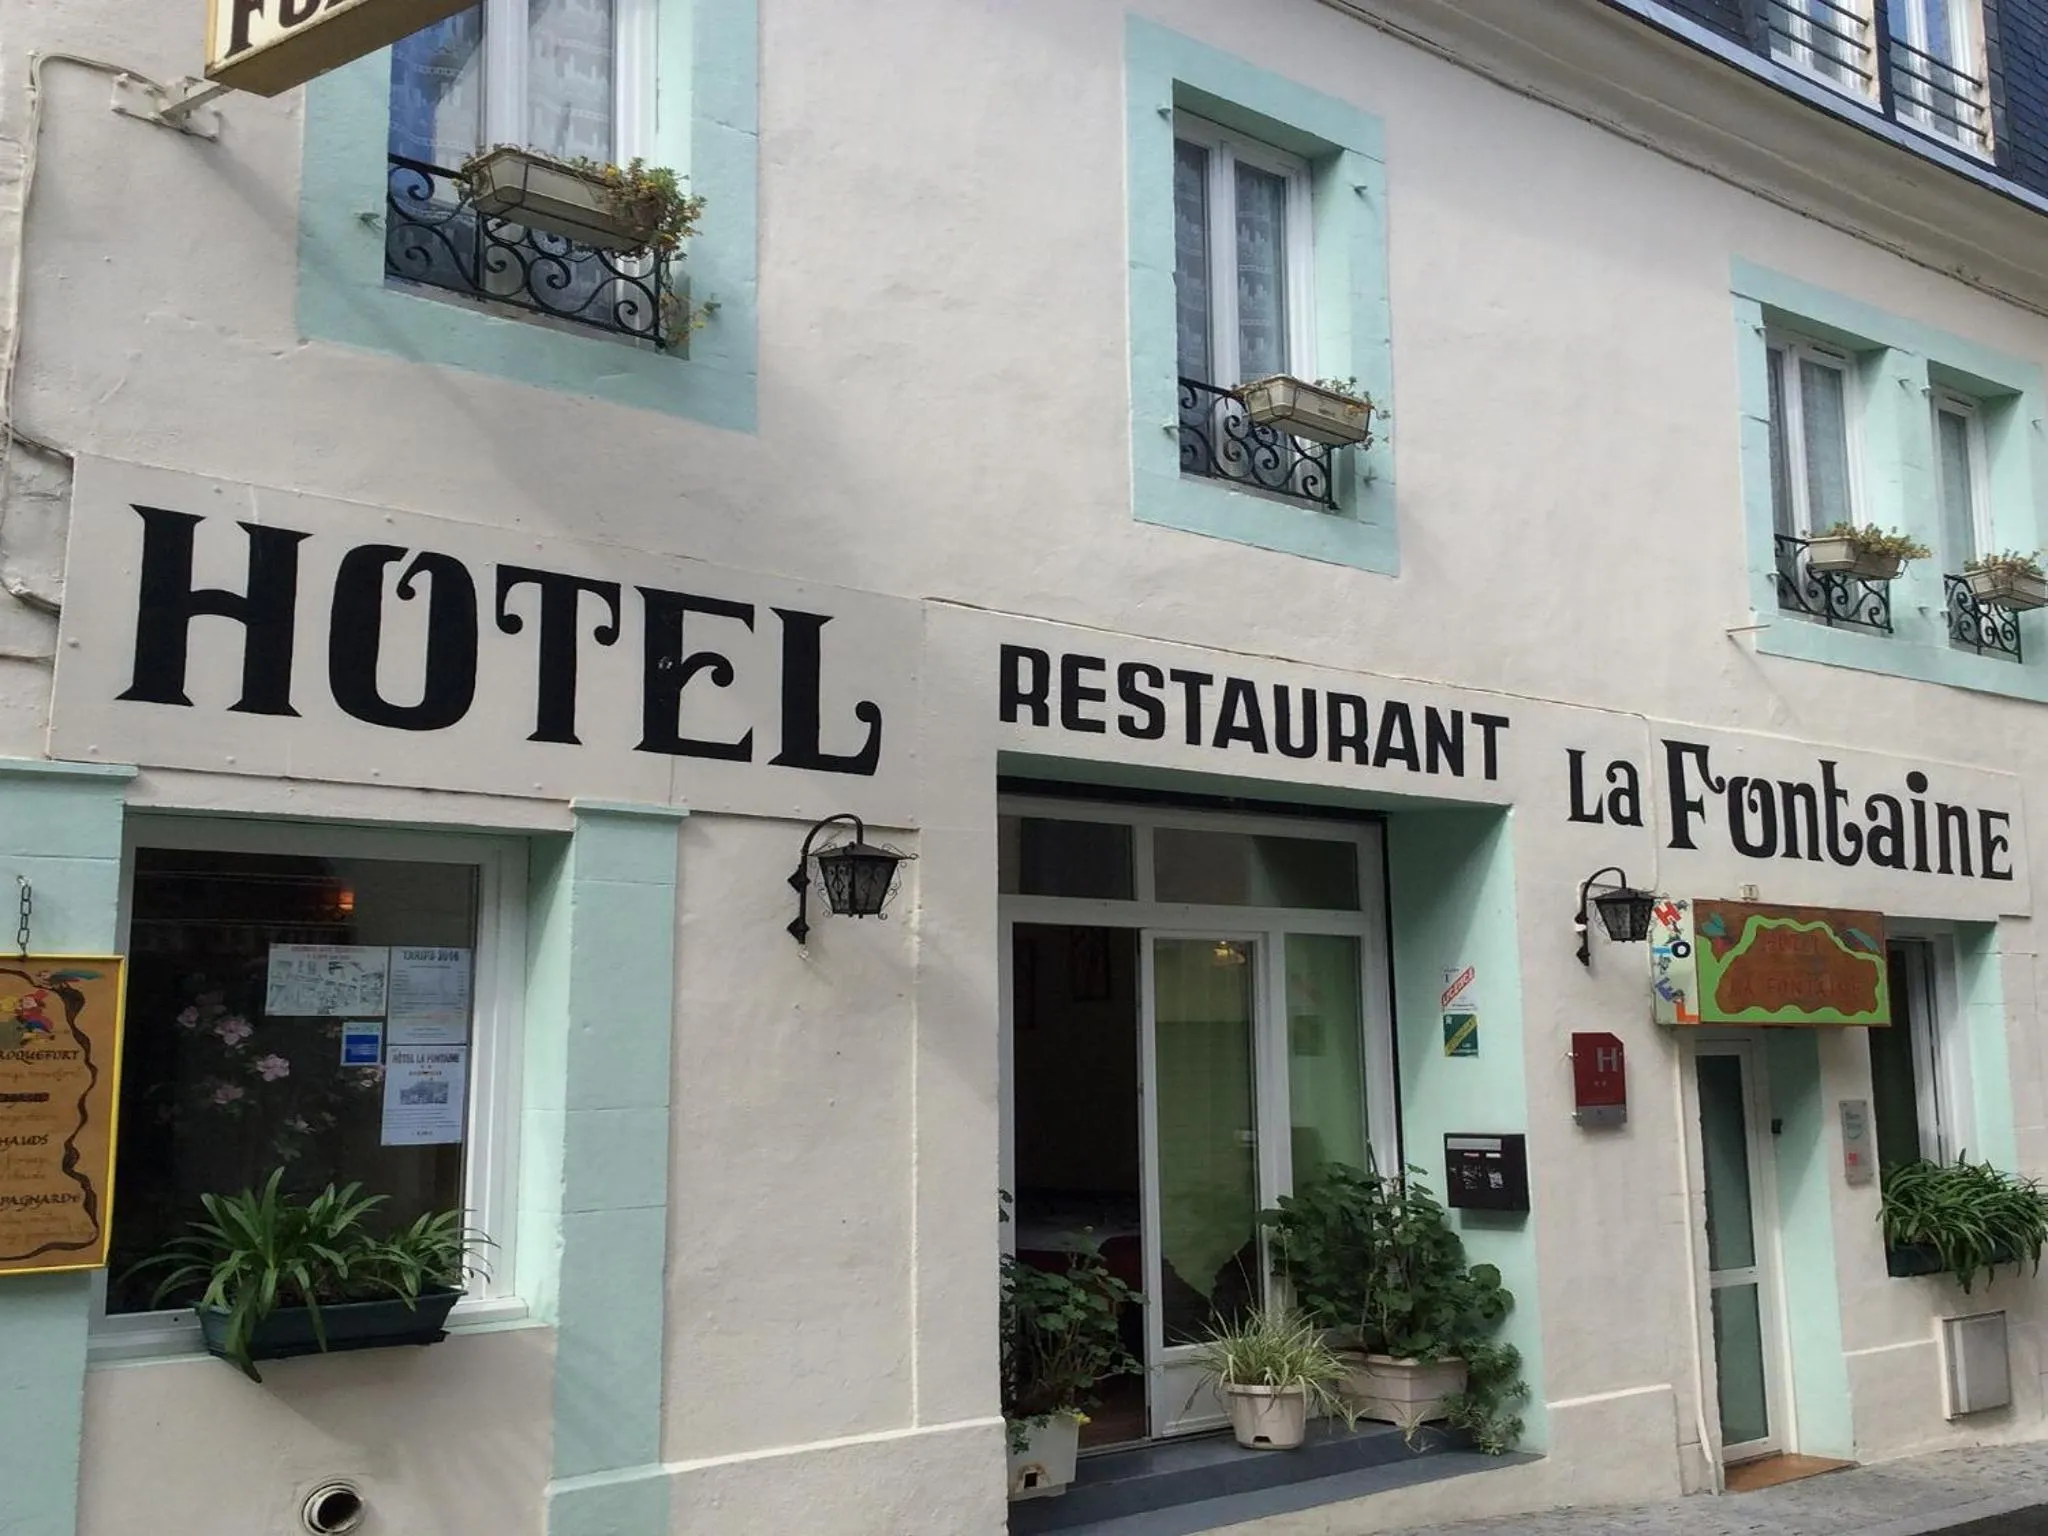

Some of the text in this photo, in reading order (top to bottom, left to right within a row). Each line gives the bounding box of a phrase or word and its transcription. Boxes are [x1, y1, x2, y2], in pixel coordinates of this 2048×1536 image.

[115, 503, 882, 777] HOTEL
[999, 643, 1510, 781] RESTAURANT
[1567, 748, 1644, 828] La
[1595, 1046, 1618, 1073] H
